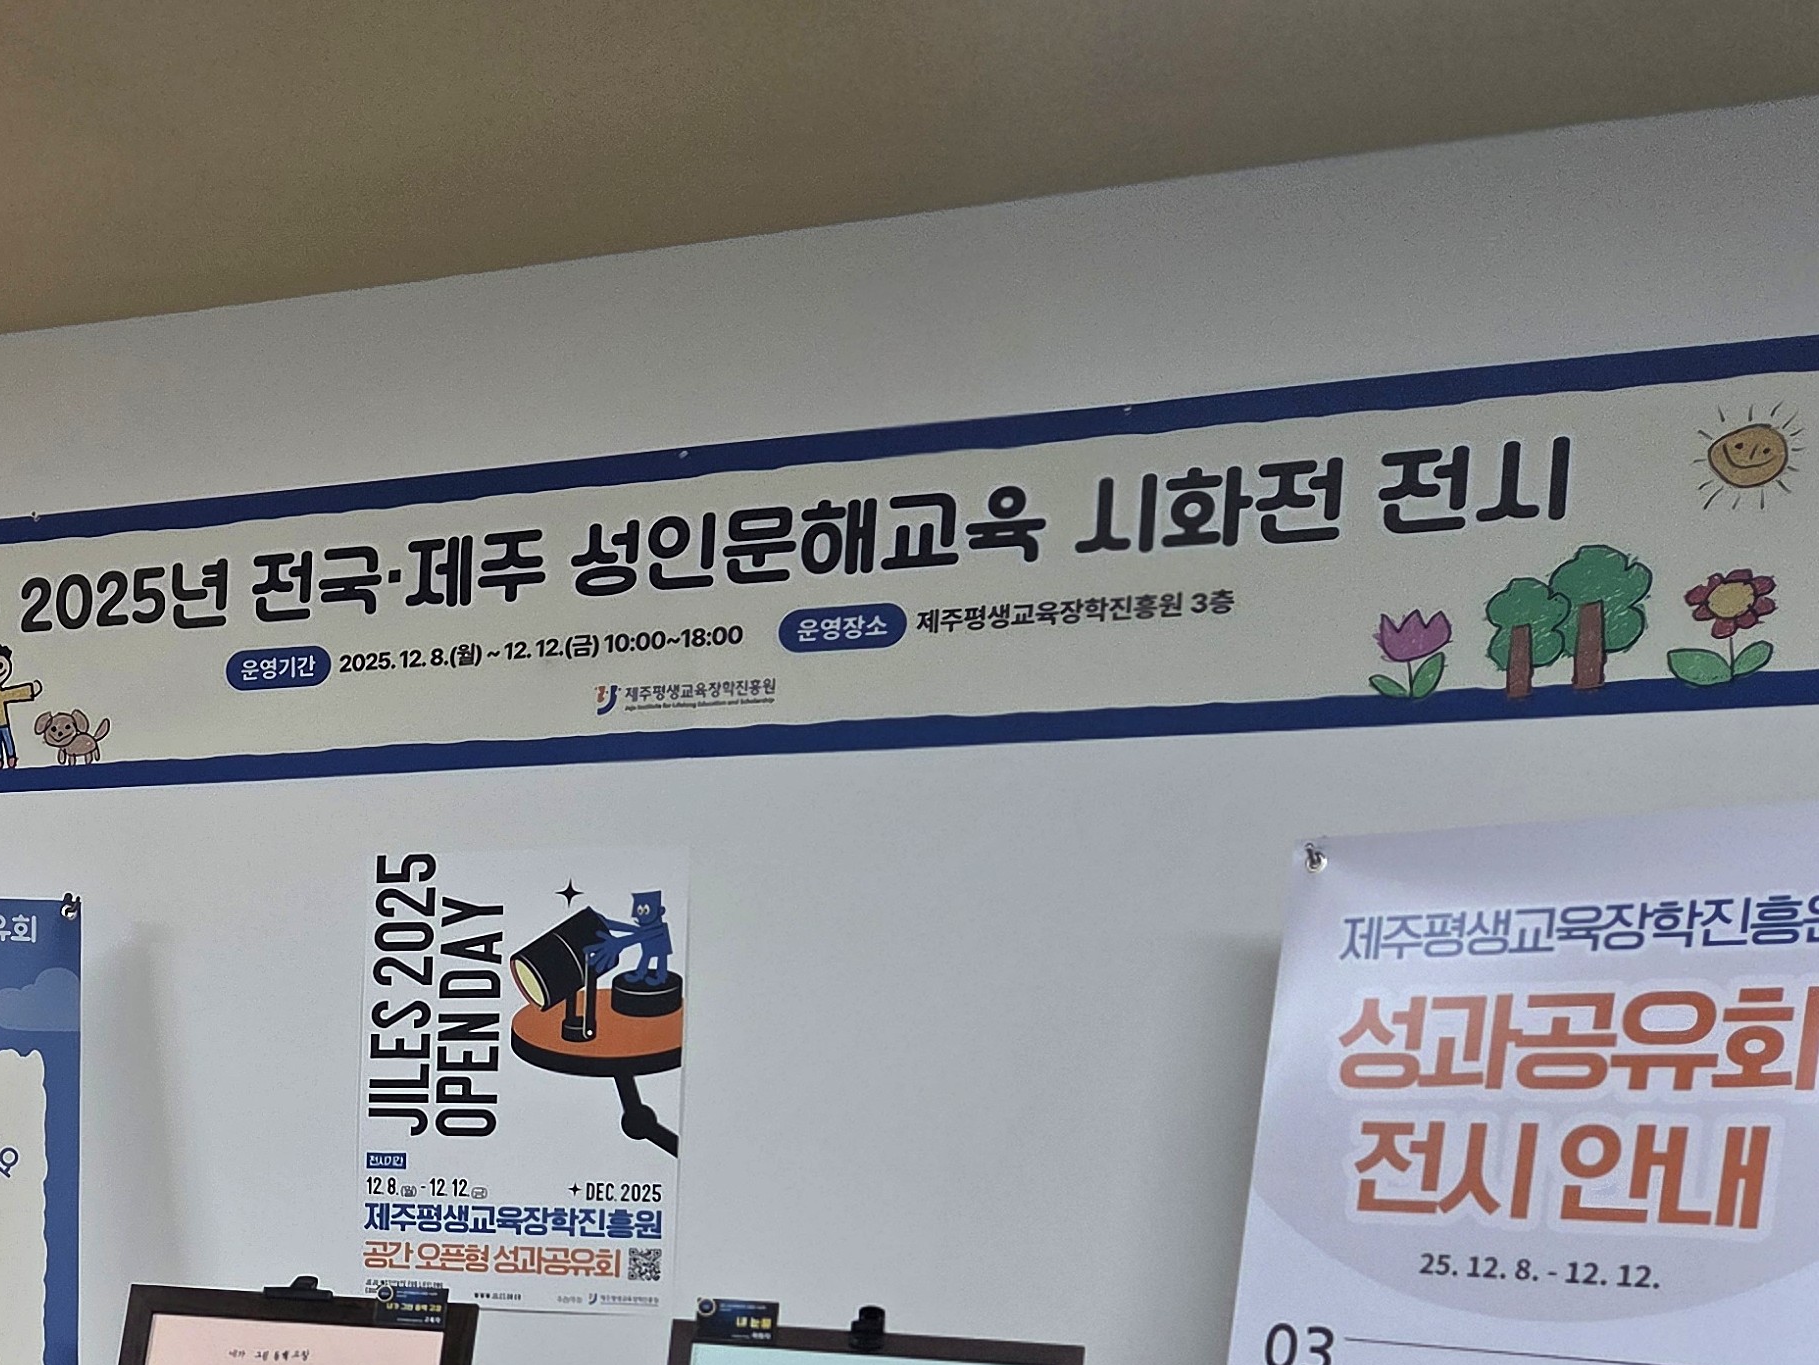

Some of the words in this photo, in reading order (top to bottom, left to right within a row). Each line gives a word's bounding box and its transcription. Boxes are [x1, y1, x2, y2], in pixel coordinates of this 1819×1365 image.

[21, 562, 229, 634] 2025년
[251, 527, 544, 622] 전국·제주
[571, 486, 1046, 597] 성인문해교육
[1074, 456, 1344, 553] 시화전
[1377, 436, 1572, 533] 전시
[796, 614, 888, 642] 운영장소
[917, 592, 1183, 633] 제주평생교육장학진흥원
[1190, 588, 1235, 615] 3층
[240, 656, 317, 681] 운영기간
[339, 652, 396, 673] 2025.
[399, 648, 427, 670] 12.
[504, 640, 533, 662] 12.
[604, 625, 744, 655] 10:00~18:00
[624, 677, 777, 702] 제주평생교육장학진흥원
[373, 853, 437, 986] 2025
[439, 896, 504, 999] DAY
[1338, 986, 1819, 1091] 성과공유회
[368, 1000, 432, 1136] JILES
[435, 1013, 500, 1136] OPEN
[585, 1182, 617, 1201] DEC.
[621, 1184, 662, 1202] 2025
[1354, 1121, 1539, 1219] 전시
[1560, 1123, 1771, 1229] 안내
[364, 1202, 662, 1239] 제주평생교육장학진흥원
[363, 1241, 413, 1270] 공간
[415, 1242, 489, 1272] 오픈형
[493, 1245, 621, 1277] 성과공유회
[1419, 1253, 1458, 1277] 25.
[1466, 1256, 1506, 1281] 12.
[1514, 1259, 1538, 1282] 8.
[1564, 1261, 1607, 1286] 12.
[1616, 1264, 1660, 1290] 12.
